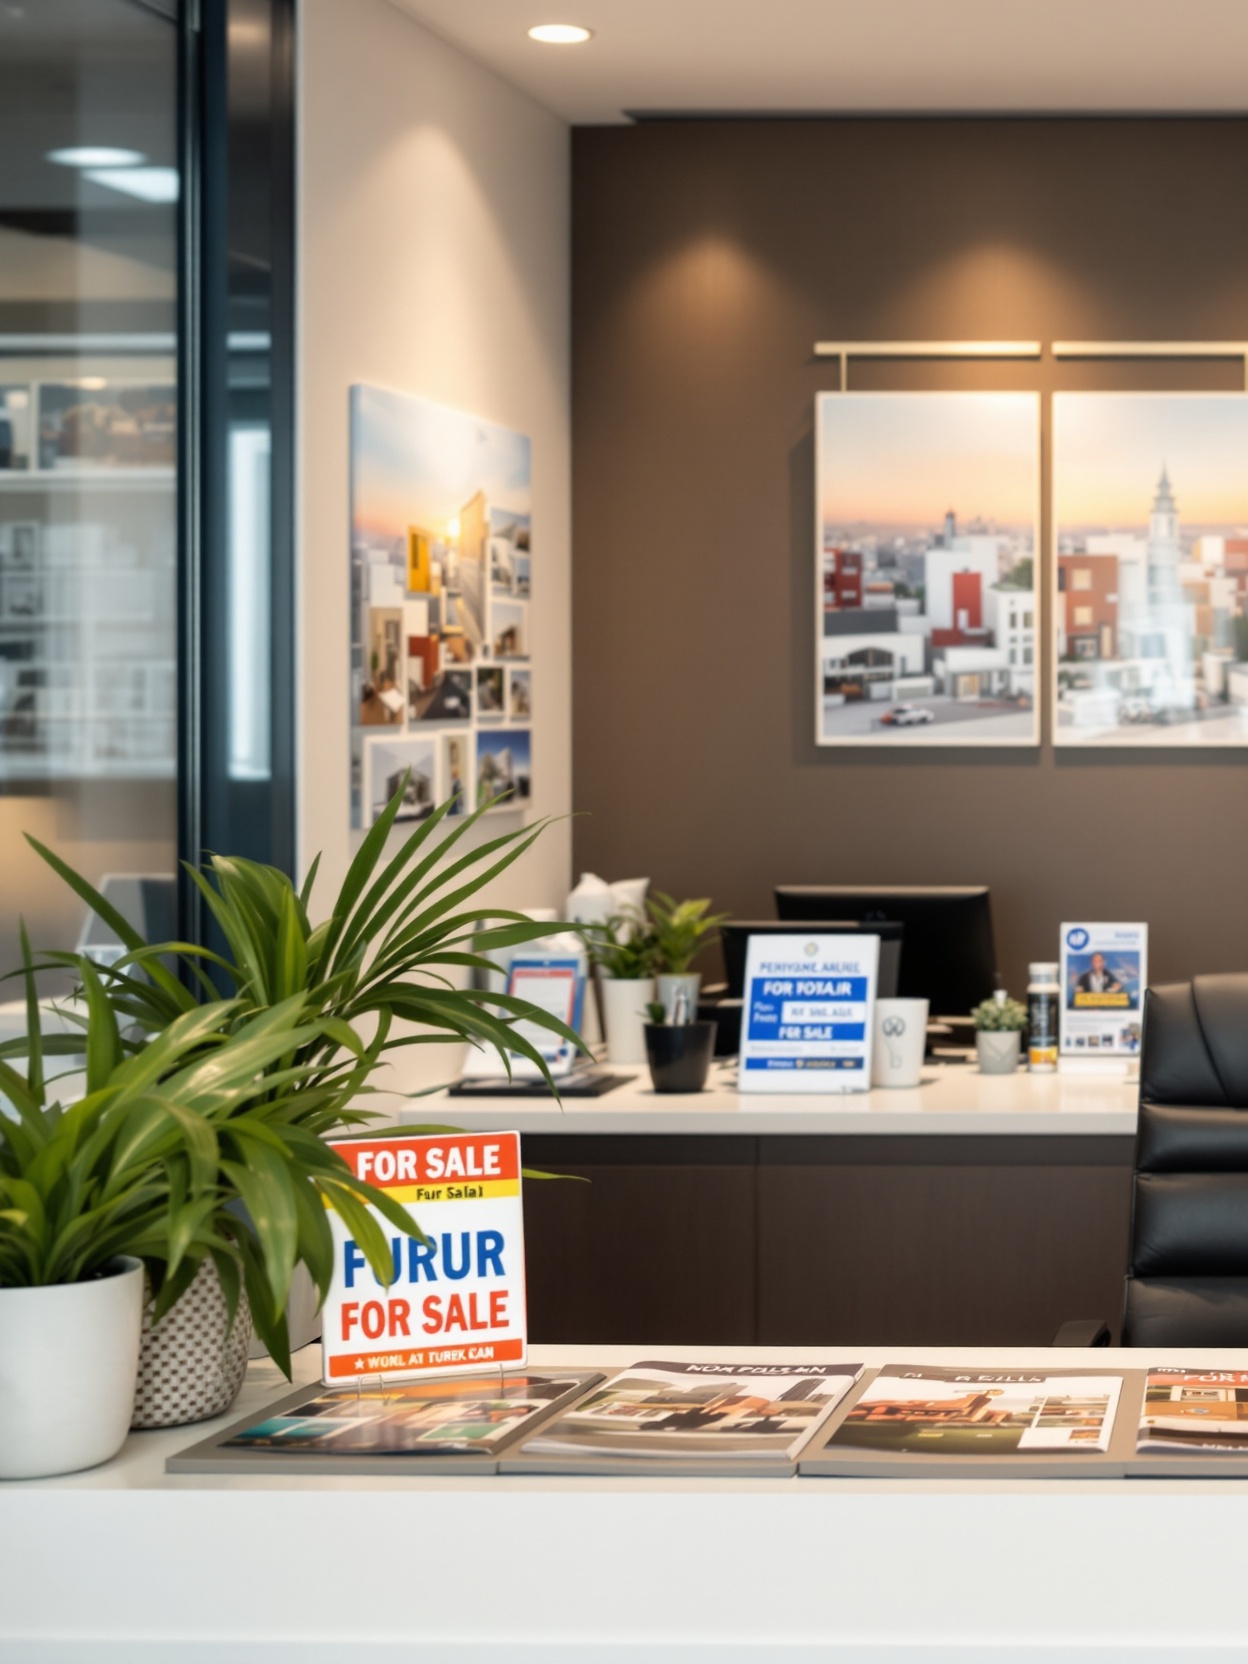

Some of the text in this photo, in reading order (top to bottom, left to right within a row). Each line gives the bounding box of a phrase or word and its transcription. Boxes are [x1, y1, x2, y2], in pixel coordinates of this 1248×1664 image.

[763, 981, 793, 996] FOR
[357, 1144, 501, 1181] FOR SALE
[341, 1289, 509, 1341] FOR SALE
